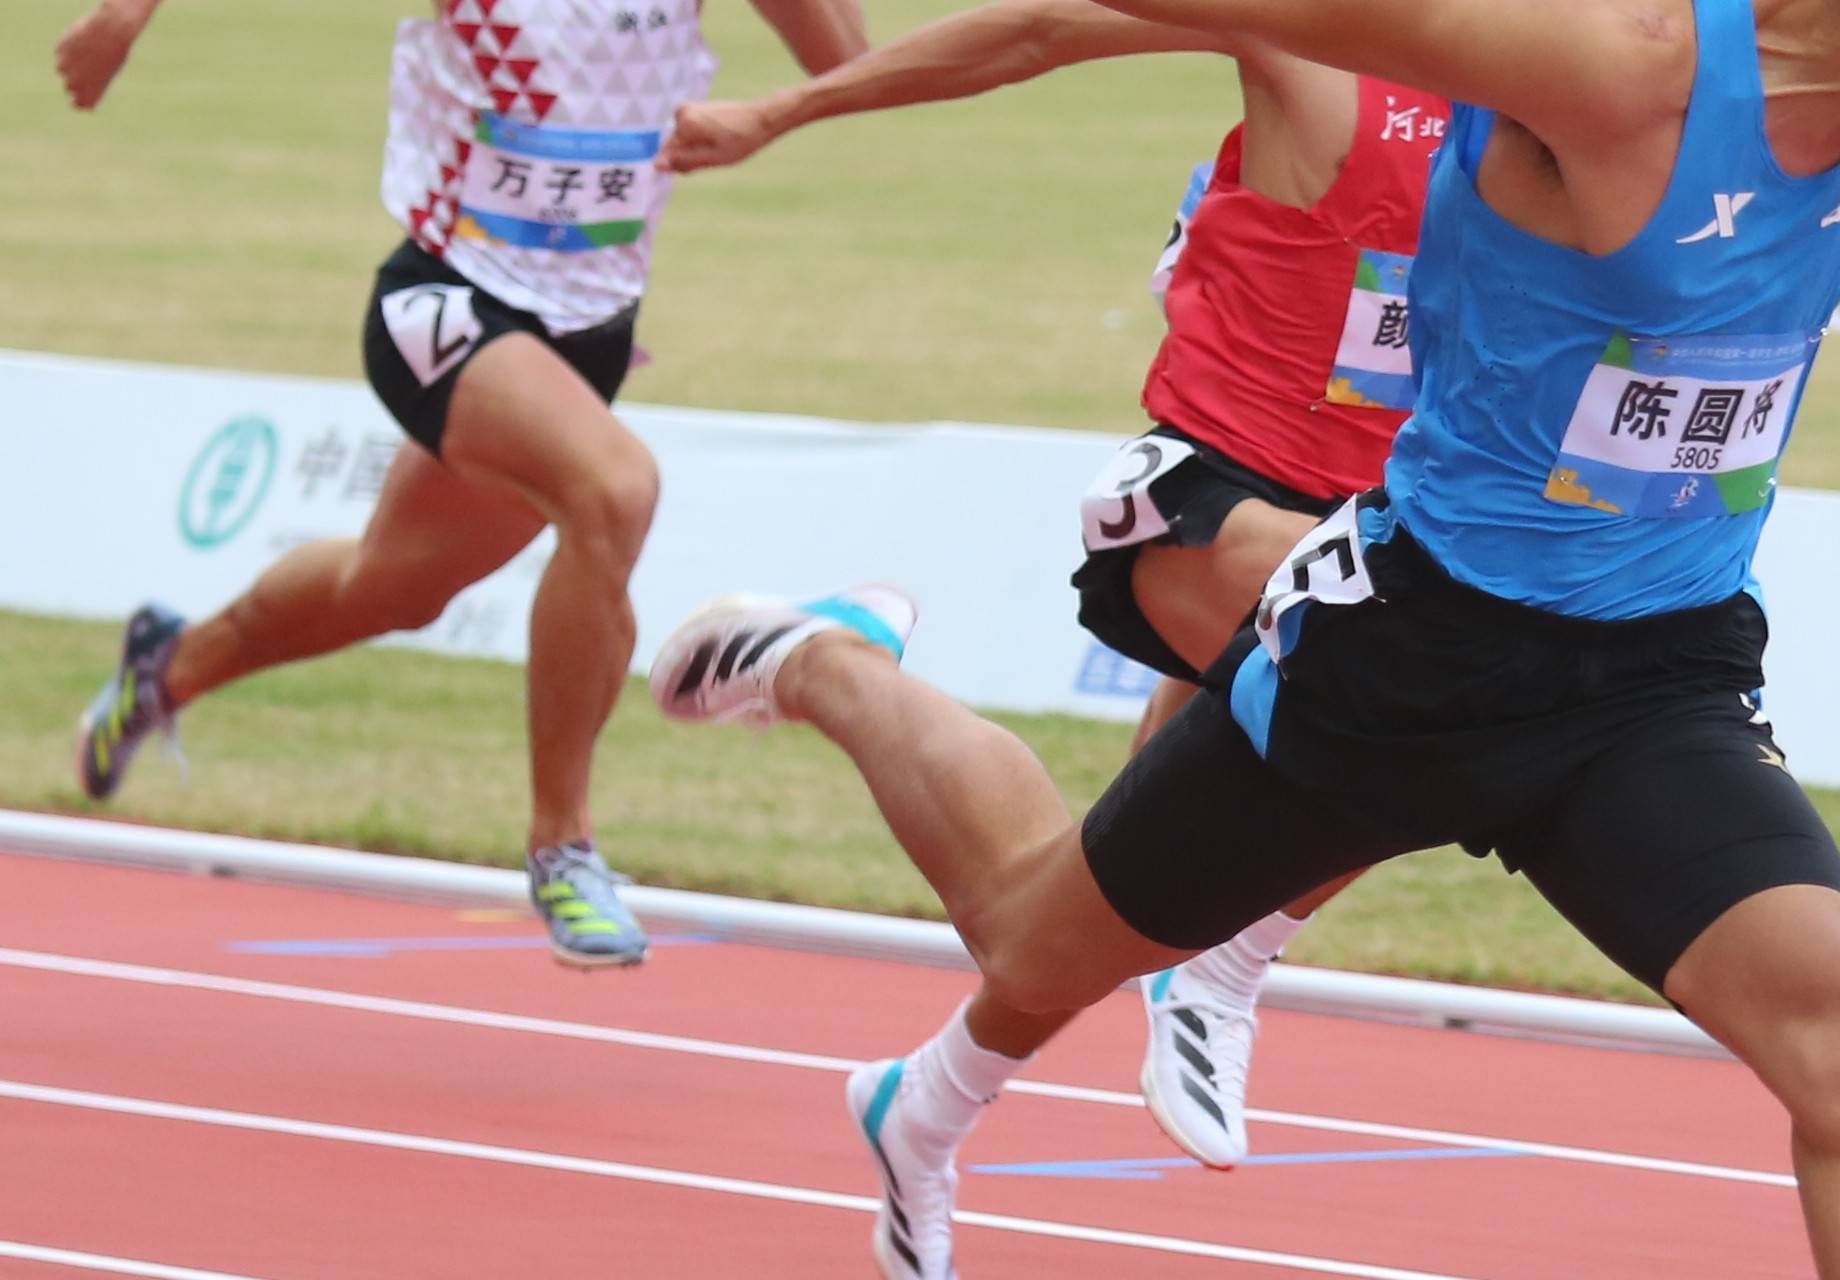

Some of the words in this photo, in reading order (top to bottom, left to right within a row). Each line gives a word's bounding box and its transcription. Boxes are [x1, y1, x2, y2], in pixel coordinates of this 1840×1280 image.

[1380, 96, 1446, 141] 河北
[490, 156, 635, 204] 万子安
[402, 290, 470, 370] 2
[1609, 379, 1784, 446] 陈圆将
[1669, 447, 1723, 470] 5805
[1098, 441, 1164, 540] 3
